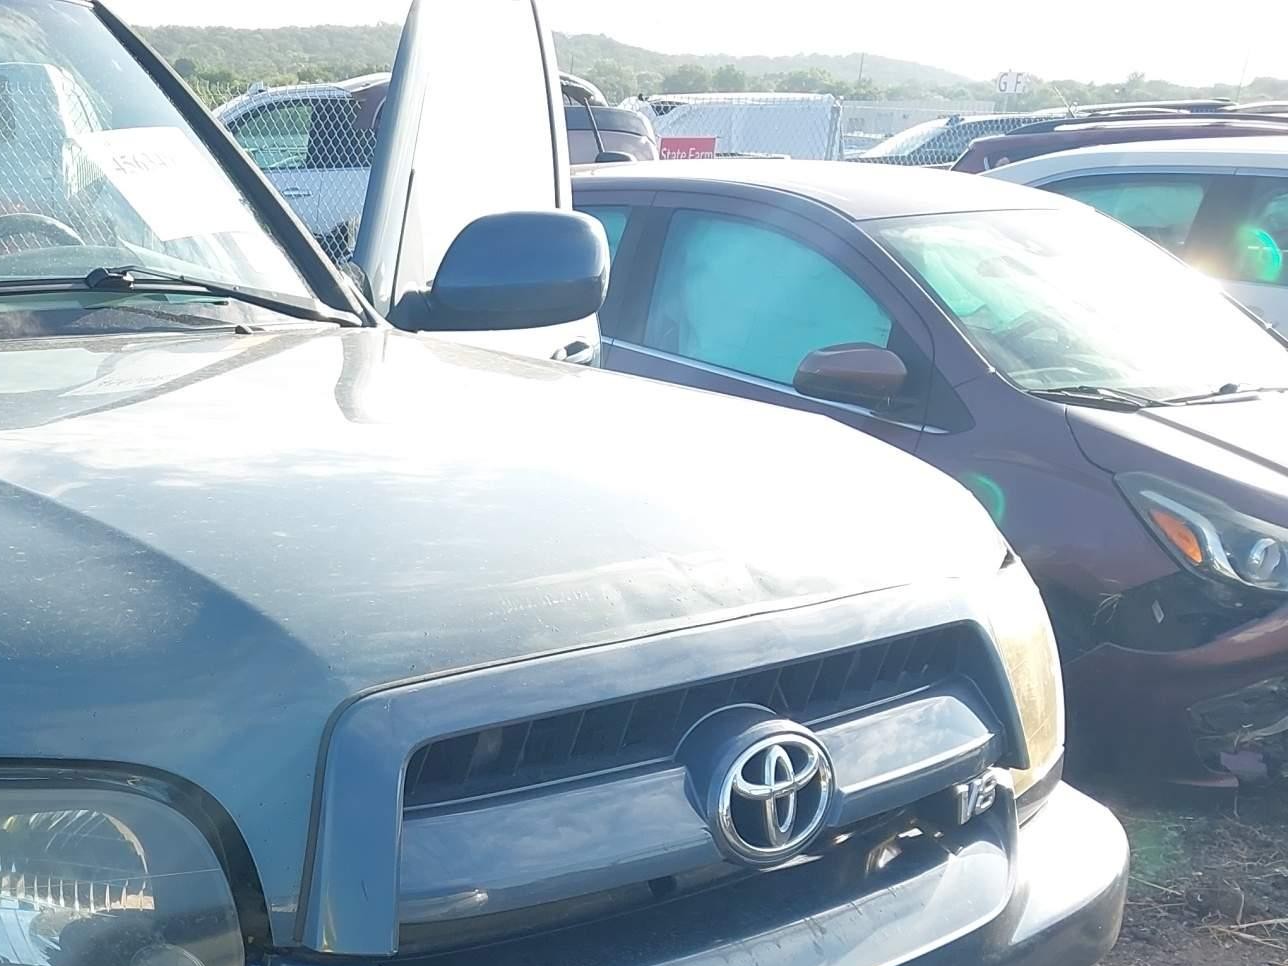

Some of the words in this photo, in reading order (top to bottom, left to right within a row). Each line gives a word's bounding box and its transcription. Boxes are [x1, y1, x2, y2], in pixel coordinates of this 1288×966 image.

[661, 147, 687, 160] State
[688, 147, 714, 160] Farm
[955, 769, 997, 825] V8
